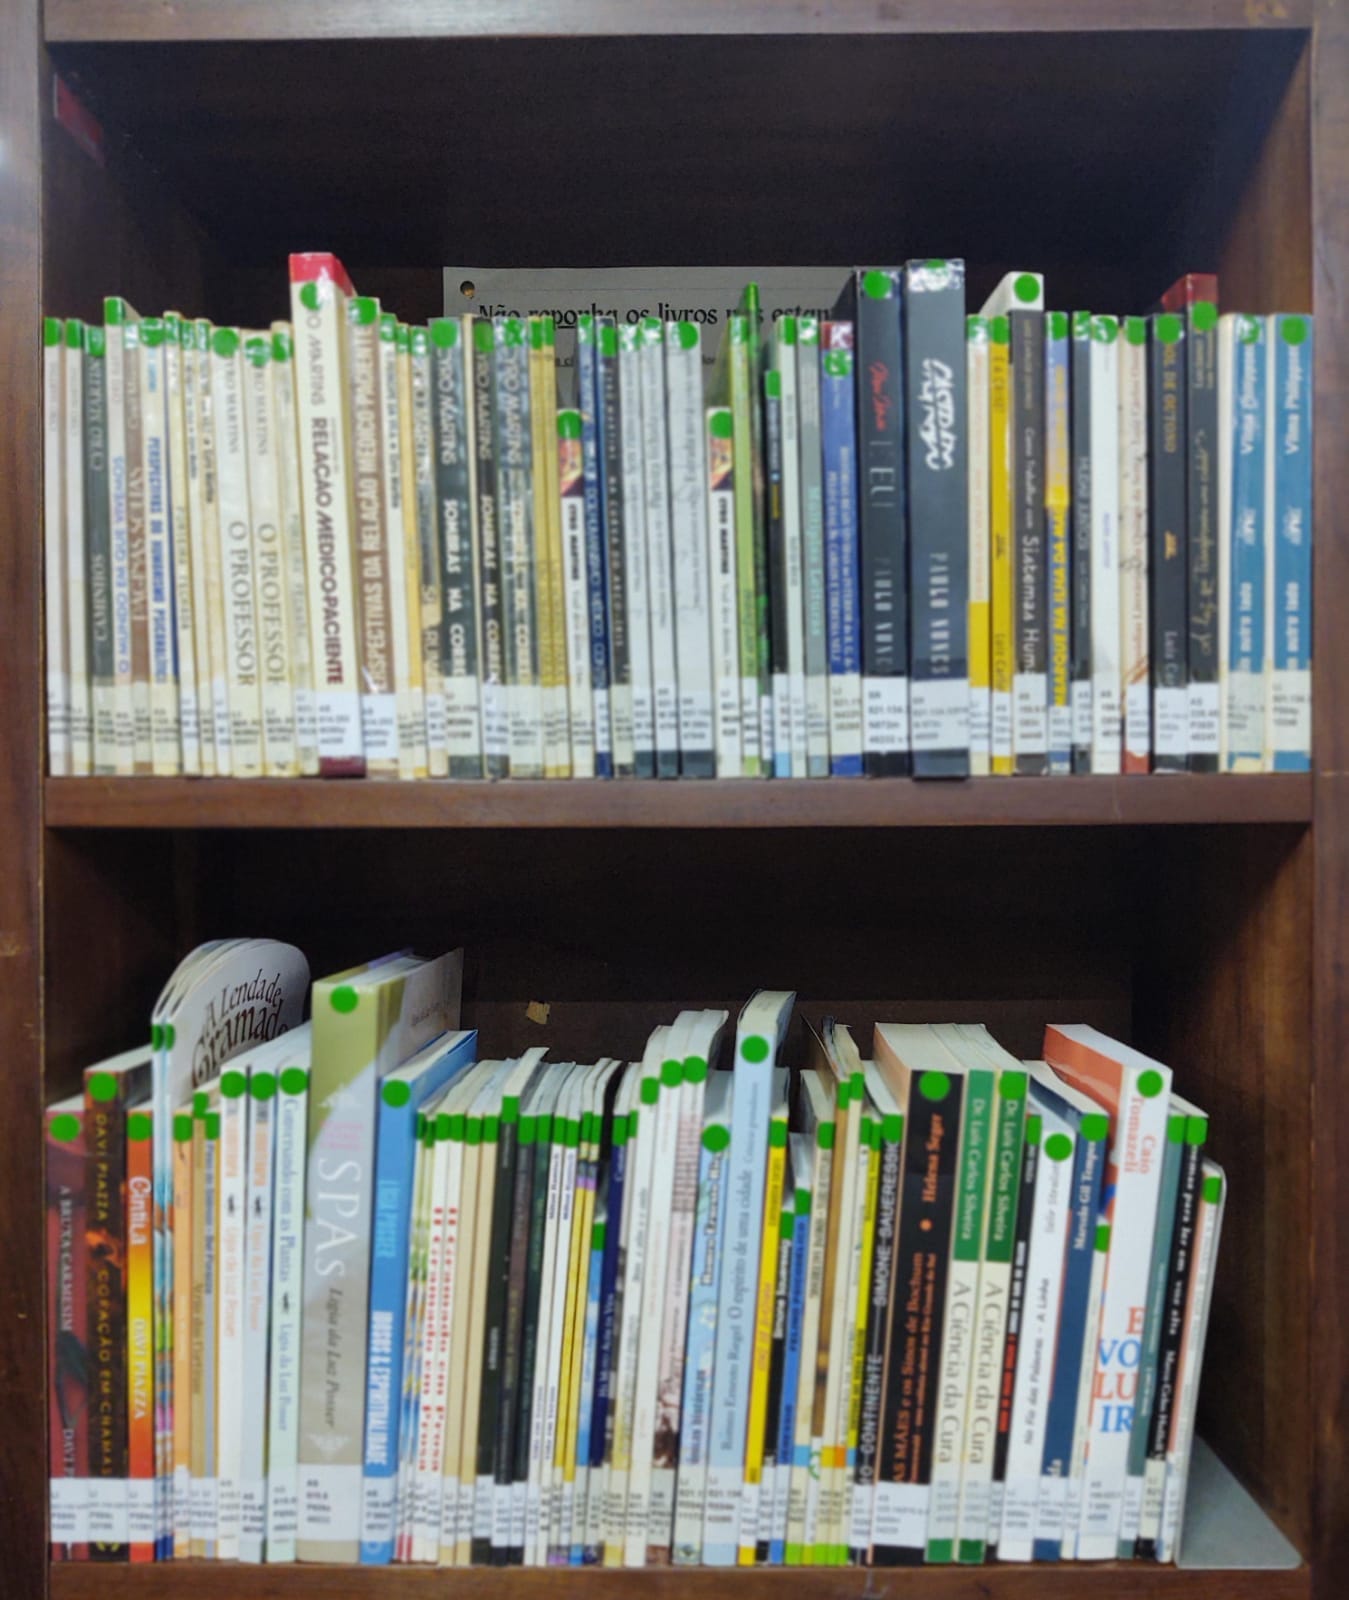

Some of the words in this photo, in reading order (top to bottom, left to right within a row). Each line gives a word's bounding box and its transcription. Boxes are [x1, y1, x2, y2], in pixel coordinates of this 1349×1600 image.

[479, 303, 520, 320] Não
[626, 306, 649, 322] os
[656, 303, 717, 322] livros
[352, 325, 375, 406] PACIENTE
[1163, 371, 1175, 390] DE
[227, 393, 240, 454] MARTINS
[256, 395, 270, 456] MARTINS
[356, 411, 378, 473] MÉDICO
[440, 395, 456, 464] MARTINS
[477, 389, 492, 460] MARTINS
[507, 391, 523, 465] MARTINS
[1023, 427, 1036, 454] Como
[1164, 393, 1176, 453] OUTONO
[1285, 413, 1300, 456] Vilma
[148, 437, 162, 514] PERSPECTIVAS
[310, 417, 334, 507] RELAÇÃO
[1023, 458, 1037, 505] Trabalhar
[1078, 455, 1090, 498] MUDAR
[112, 455, 125, 524] VIVEMOS
[608, 475, 618, 494] NA
[151, 519, 164, 535] DO
[359, 477, 384, 552] RELAÇÃO
[568, 502, 577, 528] CYRO
[609, 500, 620, 543] CURVA
[719, 498, 728, 522] CYRO
[1024, 507, 1036, 529] com
[1078, 500, 1090, 550] JUNTOS
[114, 529, 126, 561] QUE
[228, 521, 247, 541] O
[258, 523, 278, 544] O
[445, 499, 462, 573] SOMBRAS
[481, 494, 496, 569] SOMBRAS
[720, 529, 729, 574] MARTINS
[152, 540, 165, 603] HUMANISMO
[363, 556, 381, 578] DA
[570, 534, 580, 581] MARTINS
[611, 557, 621, 572] DO
[830, 543, 841, 581] CARLOS
[1053, 541, 1067, 564] DA
[91, 554, 107, 641] CAMINHOS
[115, 566, 127, 588] EM
[485, 584, 496, 607] NA
[874, 557, 894, 611] PAULO
[929, 552, 950, 608] PAULO
[1021, 534, 1041, 620] Sistemas
[1053, 567, 1067, 603] ILHA
[1238, 581, 1253, 612] lado
[1285, 581, 1301, 612] lado
[230, 549, 257, 687] PROFESSOR
[448, 588, 463, 612] NA
[612, 576, 625, 648] ARCO-ÍRIS
[1053, 606, 1067, 630] NA
[116, 591, 129, 658] MUNDO
[363, 582, 388, 692] ERSPECTIVAS
[1239, 616, 1253, 653] outro
[1286, 616, 1301, 653] outro
[930, 618, 950, 675] NUNES
[971, 1098, 985, 1118] Dr.
[1003, 1099, 1019, 1119] Dr.
[95, 1113, 111, 1158] DAVI
[281, 1098, 300, 1185] Conversando
[925, 1112, 943, 1151] Seger
[1124, 1096, 1147, 1174] Tomazeli
[966, 1149, 982, 1192] Carlos
[997, 1150, 1014, 1193] Carlos
[1138, 1135, 1158, 1176] Caio
[60, 1185, 75, 1194] A
[95, 1162, 111, 1221] PIAZZA
[735, 1169, 752, 1210] cidade
[923, 1153, 939, 1203] Helena
[1078, 1184, 1091, 1203] Gil
[281, 1186, 297, 1215] com
[706, 1183, 720, 1237] Ernesto
[961, 1193, 979, 1240] Silveira
[993, 1194, 1012, 1241] Silveira
[1183, 1192, 1196, 1223] para
[60, 1196, 75, 1250] BRUXA
[281, 1218, 296, 1232] as
[377, 1213, 398, 1258] POSSER
[736, 1211, 749, 1239] uma
[1074, 1205, 1090, 1250] Marcelo
[1181, 1225, 1192, 1247] ler
[279, 1233, 297, 1283] Plantas
[733, 1239, 747, 1253] de
[927, 1252, 936, 1269] Sul
[1177, 1249, 1187, 1273] em
[60, 1251, 74, 1331] CARMESIM
[729, 1254, 747, 1305] espírito
[873, 1246, 890, 1307] SIMONE
[907, 1252, 923, 1313] Bochum
[953, 1280, 971, 1297] A
[986, 1280, 1006, 1297] A
[95, 1269, 113, 1362] CORAÇÃO
[727, 1307, 743, 1320] O
[922, 1283, 933, 1315] Grande
[131, 1317, 146, 1356] DAVI
[190, 1318, 203, 1338] das
[326, 1328, 343, 1349] da
[371, 1309, 394, 1351] IDOSOS
[906, 1315, 917, 1334] de
[945, 1301, 970, 1370] Ciência
[977, 1302, 1003, 1371] Ciência
[1127, 1307, 1146, 1334] E
[1169, 1308, 1182, 1336] alta
[278, 1351, 293, 1368] da
[725, 1325, 743, 1361] Riegel
[902, 1336, 917, 1376] Sinos
[1026, 1386, 1038, 1406] das
[1038, 1277, 1050, 1309] Linha
[1098, 1339, 1145, 1369] VO
[98, 1368, 112, 1394] EM
[190, 1341, 203, 1395] Cortinas
[277, 1371, 293, 1395] Luz
[325, 1353, 342, 1377] Luz
[723, 1362, 738, 1408] Ernesto
[131, 1358, 147, 1419] PIAZZA
[324, 1380, 342, 1428] Posser
[863, 1352, 884, 1454] CONTINENTE
[901, 1397, 911, 1407] e
[902, 1377, 913, 1396] os
[944, 1388, 963, 1412] da
[975, 1388, 996, 1413] da
[1094, 1372, 1144, 1400] LU
[276, 1399, 293, 1431] Posser
[366, 1367, 391, 1467] ESPIRITUALIDADE
[894, 1410, 911, 1461] MÃES
[1099, 1405, 1138, 1434] IR
[62, 1428, 76, 1465] DAVI
[98, 1400, 114, 1478] CHAMAS
[939, 1417, 960, 1464] Cura
[968, 1418, 992, 1466] Cura
[894, 1462, 907, 1482] AS
